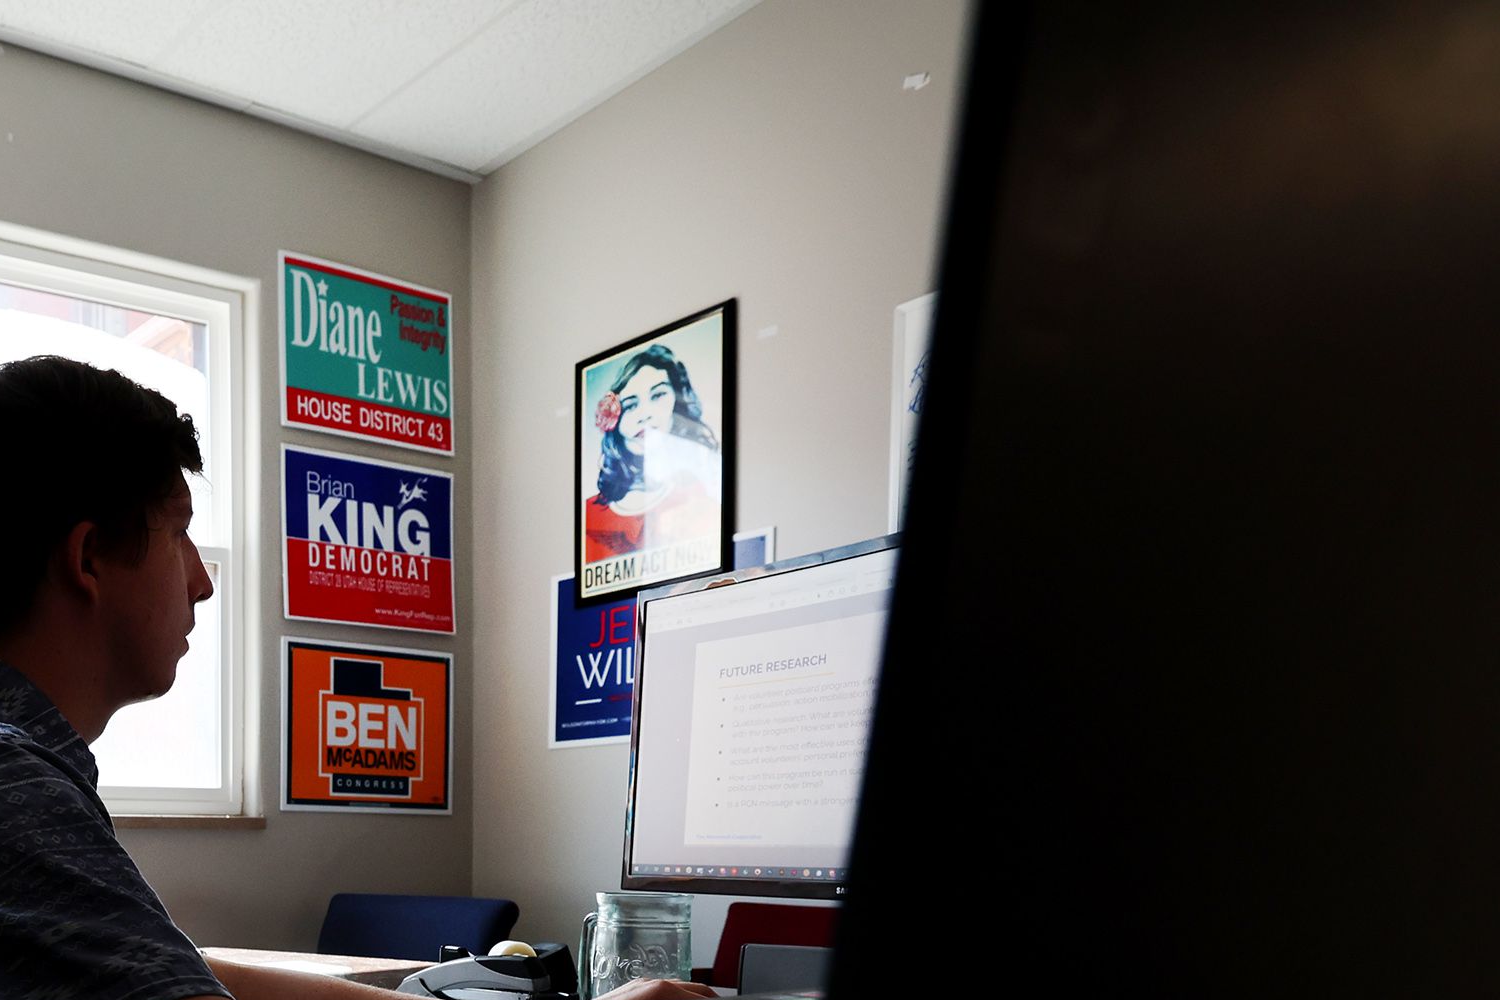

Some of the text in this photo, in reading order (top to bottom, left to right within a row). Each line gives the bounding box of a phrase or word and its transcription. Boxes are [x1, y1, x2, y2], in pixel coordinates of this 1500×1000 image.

[289, 268, 382, 364] Diane
[357, 362, 448, 415] LEWIS
[297, 394, 443, 442] HOUSE DISTRICT 43
[306, 471, 355, 499] Brian
[307, 493, 431, 557] KING
[308, 542, 431, 582] DEMOCRAT
[585, 557, 635, 589] DREAM
[640, 548, 668, 576] ACT
[588, 603, 637, 648] JE
[719, 653, 827, 679] FUTURE RESEARCH
[326, 700, 417, 750] BEN
[326, 747, 416, 772] McADAMS
[336, 777, 404, 790] CONGRESS
